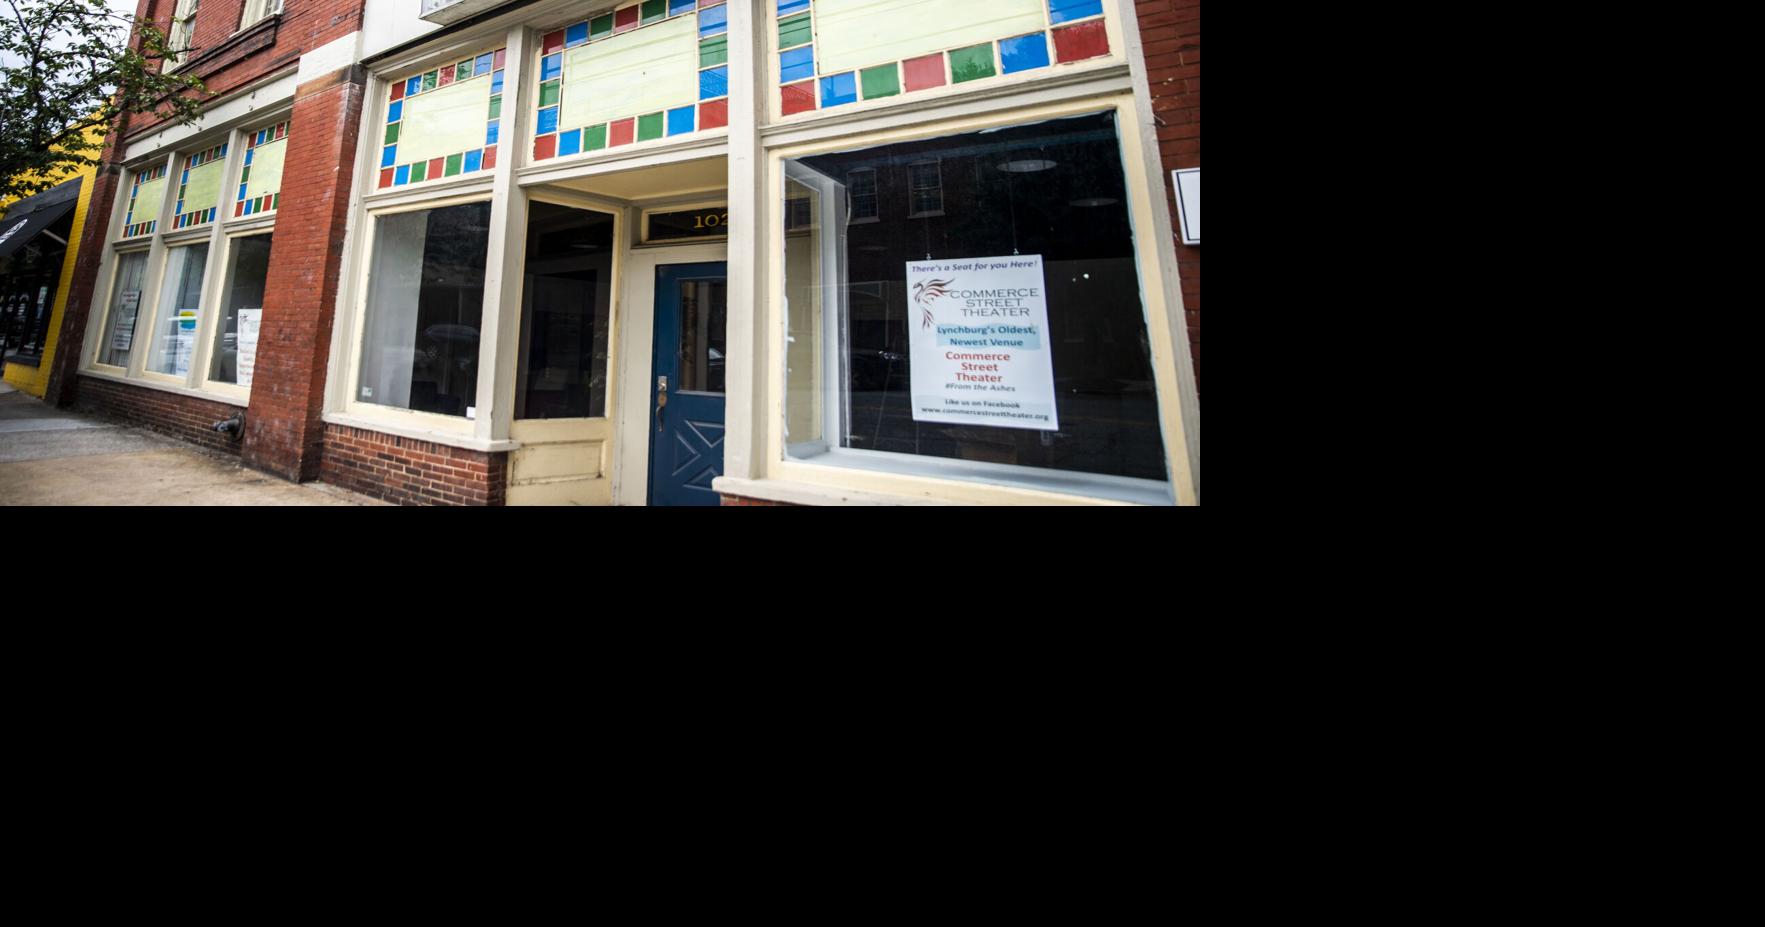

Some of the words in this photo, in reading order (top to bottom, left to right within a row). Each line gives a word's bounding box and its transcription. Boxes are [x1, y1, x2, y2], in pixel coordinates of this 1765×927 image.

[952, 263, 972, 271] Seat
[974, 262, 988, 271] for
[990, 262, 1008, 270] you
[1010, 260, 1038, 268] Here!
[949, 288, 1040, 299] COMMERCE
[966, 298, 1024, 308] STREET
[960, 307, 1030, 317] THEATER
[937, 326, 995, 335] Lynchburg's
[998, 326, 1036, 334] Oldest,
[950, 338, 987, 346] Newest
[990, 338, 1024, 346] Venue
[945, 351, 1011, 361] Commerce
[961, 362, 998, 371] Street
[955, 372, 1003, 382] Theater
[974, 383, 987, 391] the
